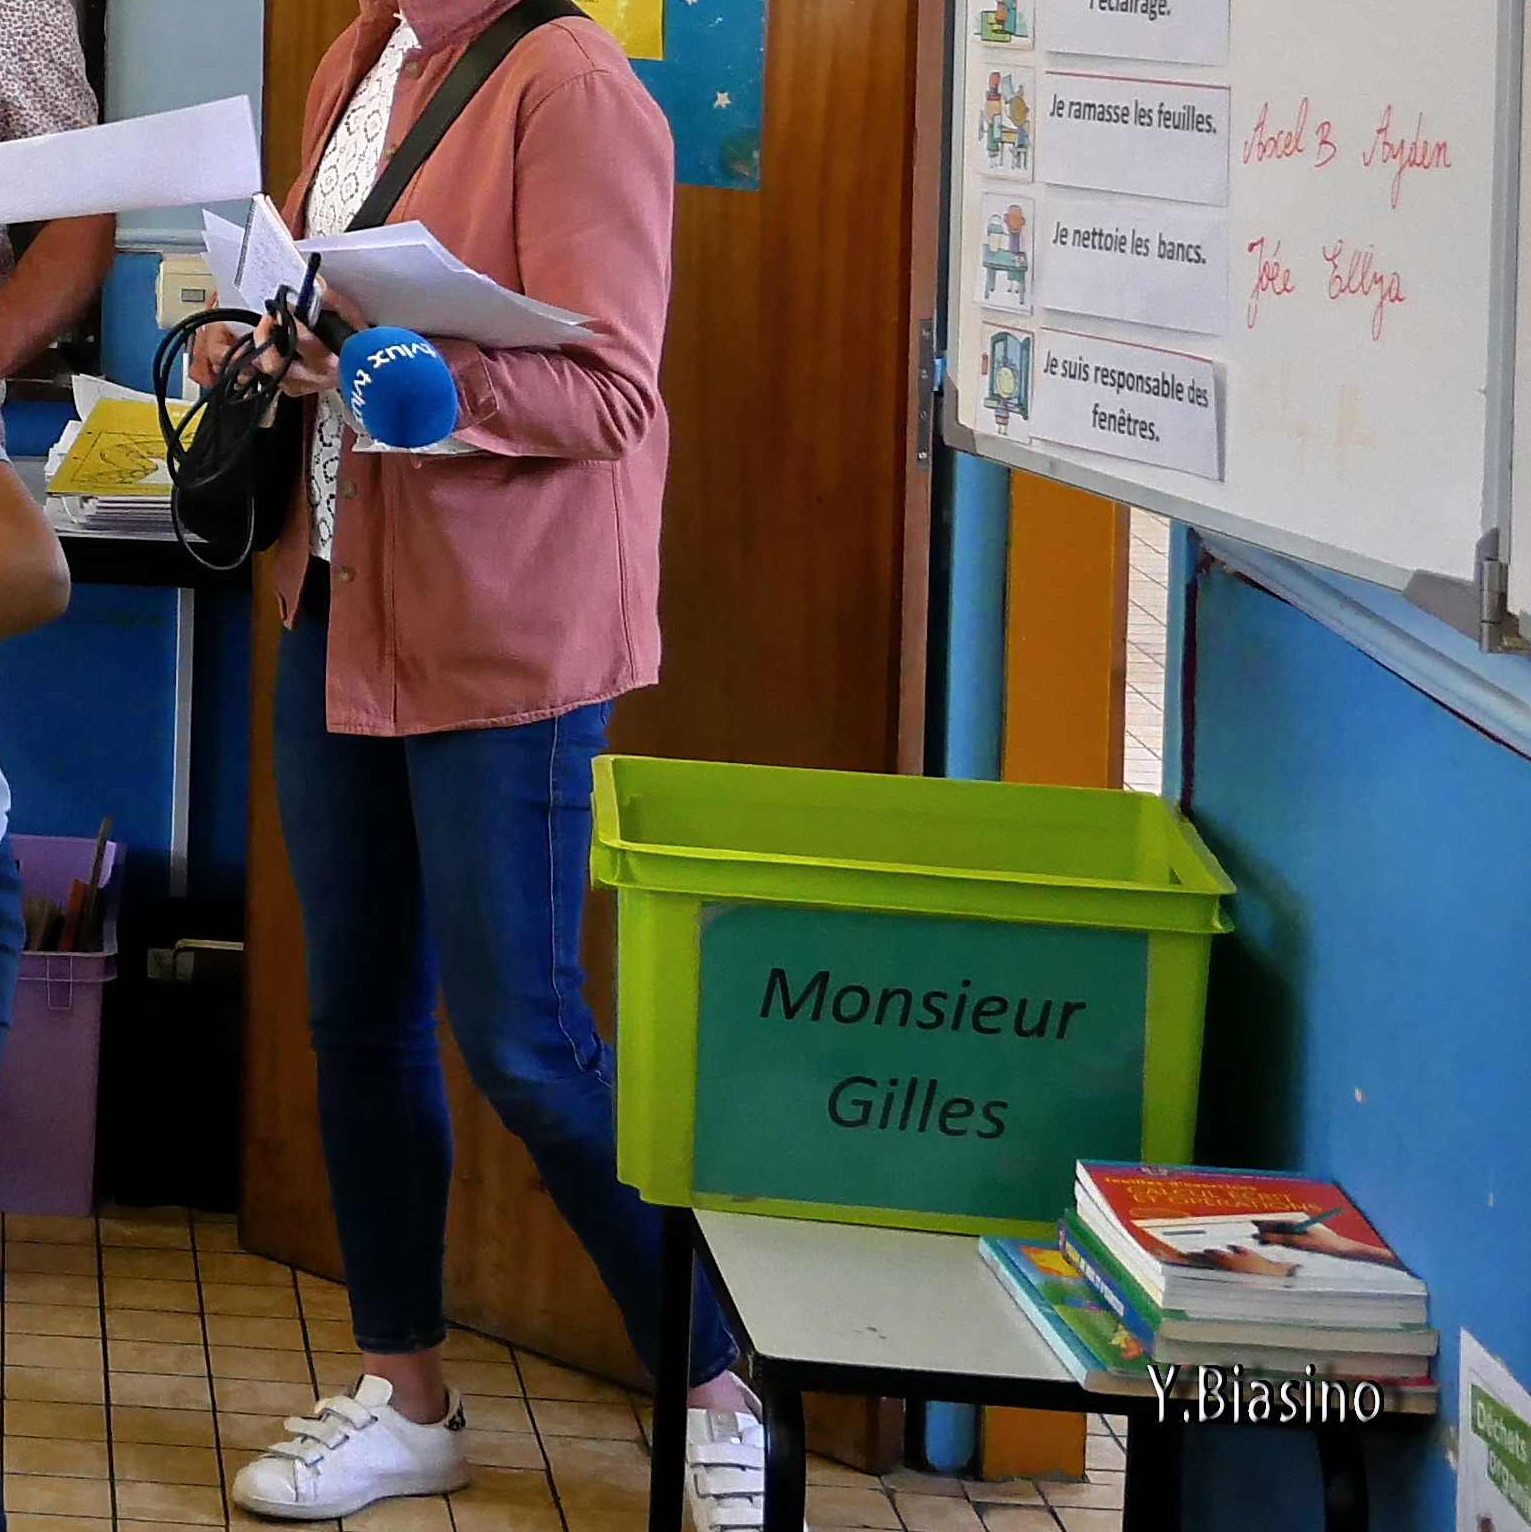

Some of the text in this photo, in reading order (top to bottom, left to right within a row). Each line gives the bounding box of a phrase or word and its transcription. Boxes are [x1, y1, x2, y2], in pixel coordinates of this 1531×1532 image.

[1049, 93, 1217, 134] Je ramasse les feuilles.
[1243, 96, 1308, 164] Axel
[1314, 120, 1337, 167] B
[1052, 221, 1207, 265] Je nettoie les bancs.
[1043, 350, 1209, 408] Je suis responsable des
[1092, 403, 1160, 442] fenêtres.
[759, 967, 1087, 1040] Monsieur
[827, 1075, 1009, 1139] Gilles
